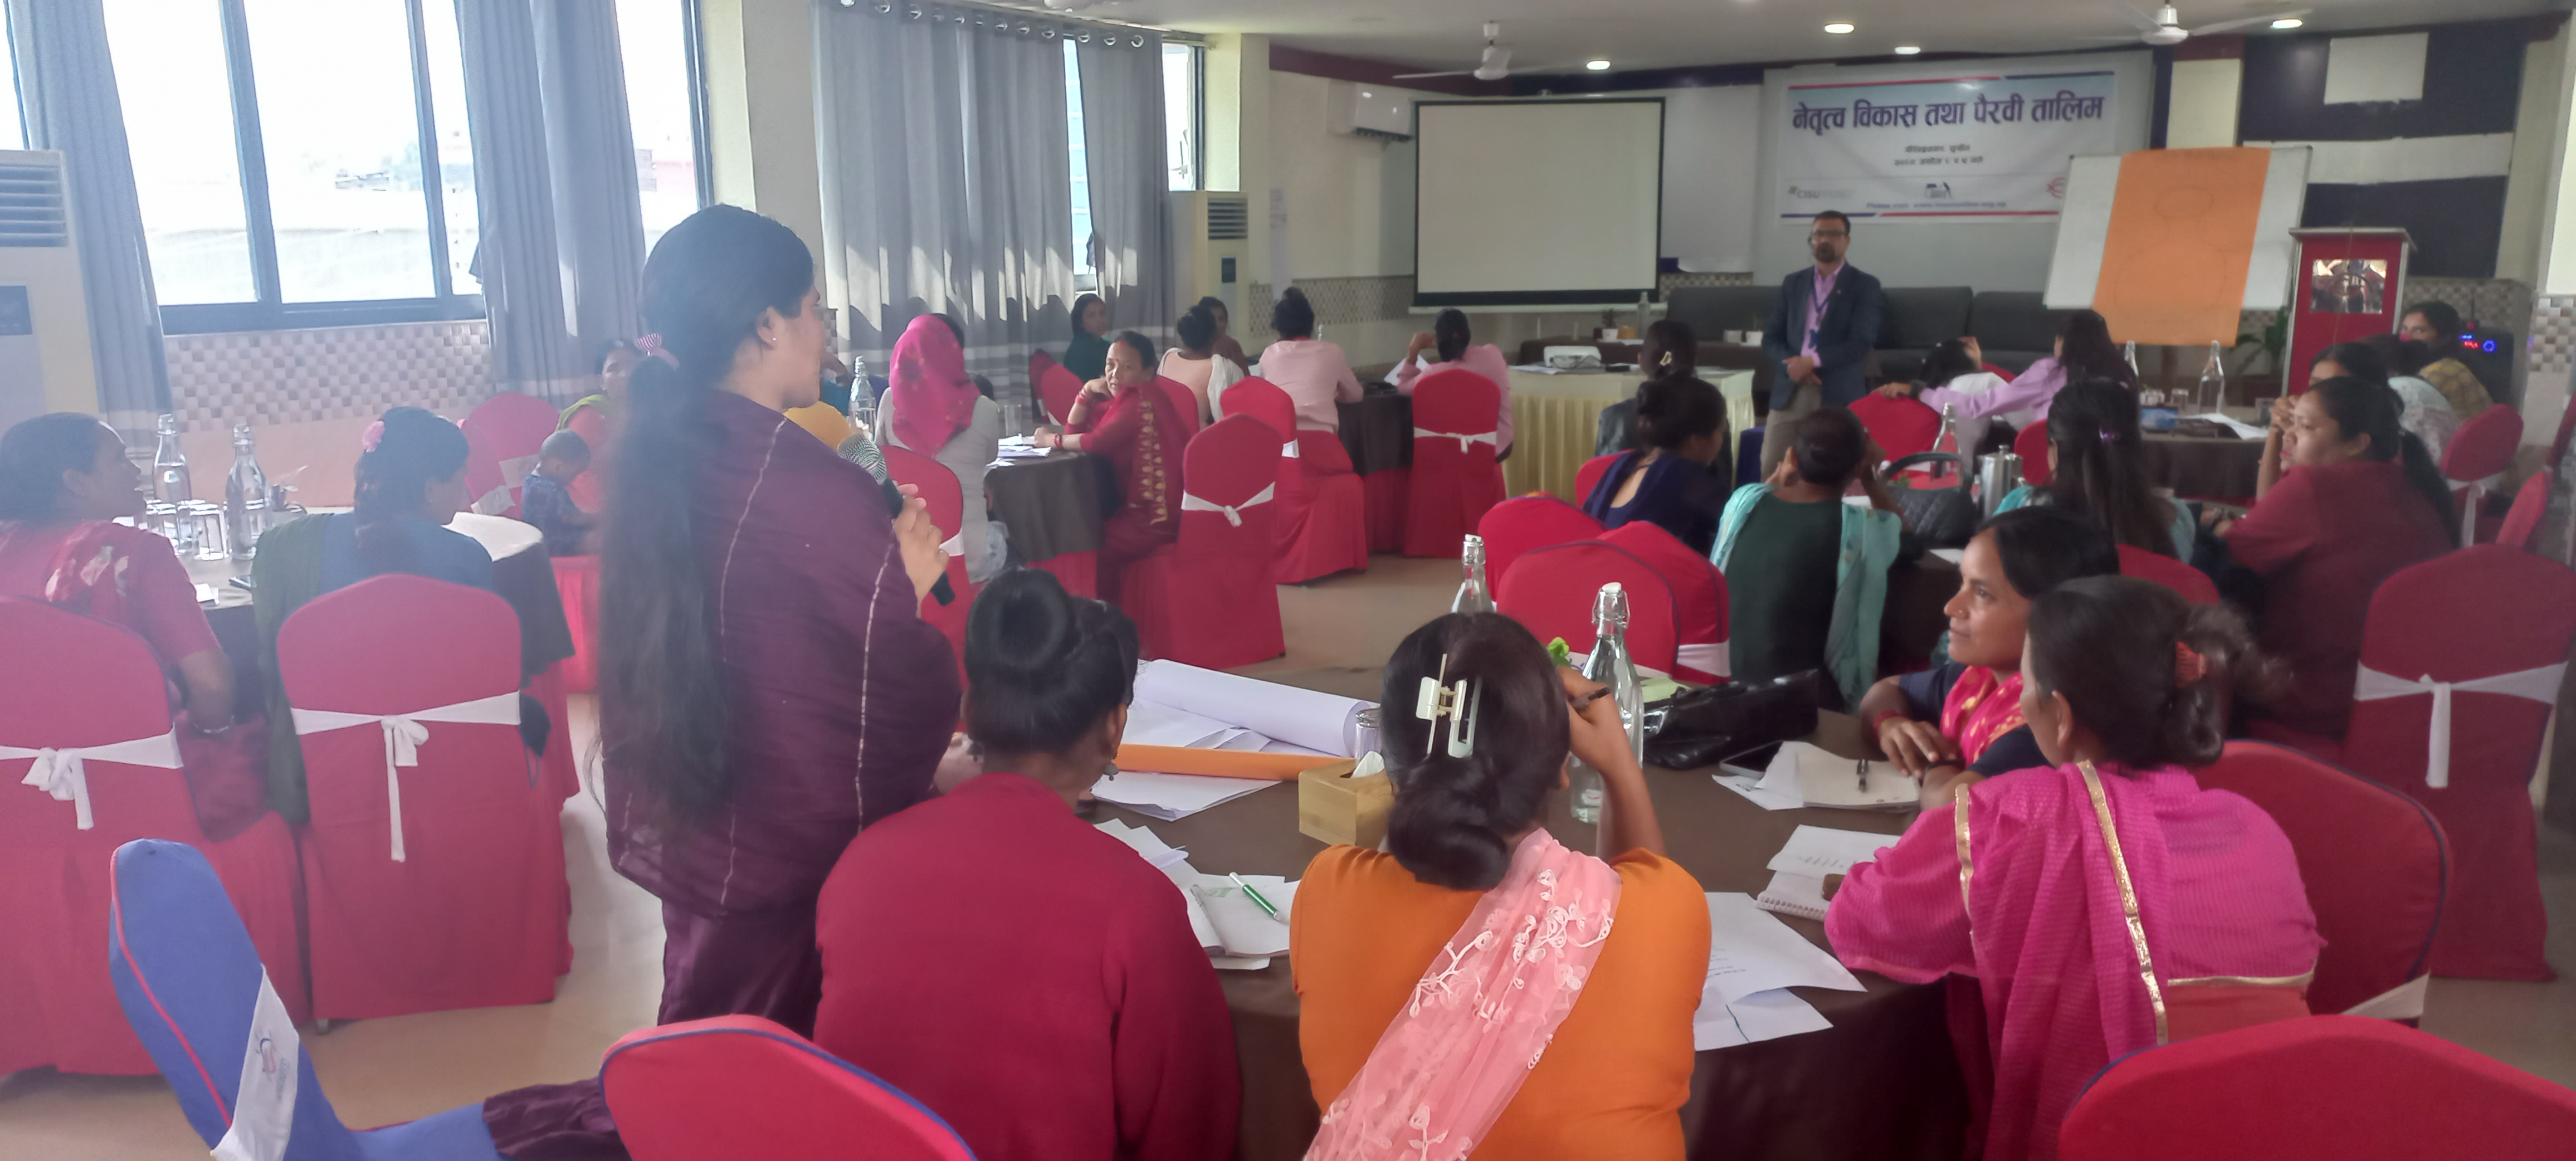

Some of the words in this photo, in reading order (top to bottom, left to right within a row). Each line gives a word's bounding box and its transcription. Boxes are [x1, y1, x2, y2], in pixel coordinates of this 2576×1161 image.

[1793, 102, 1846, 135] नेतृत्व
[1853, 99, 1918, 128] विकास
[1925, 103, 1966, 126] तथा
[1974, 92, 2025, 124] पैरवी
[2032, 90, 2104, 122] तालिम
